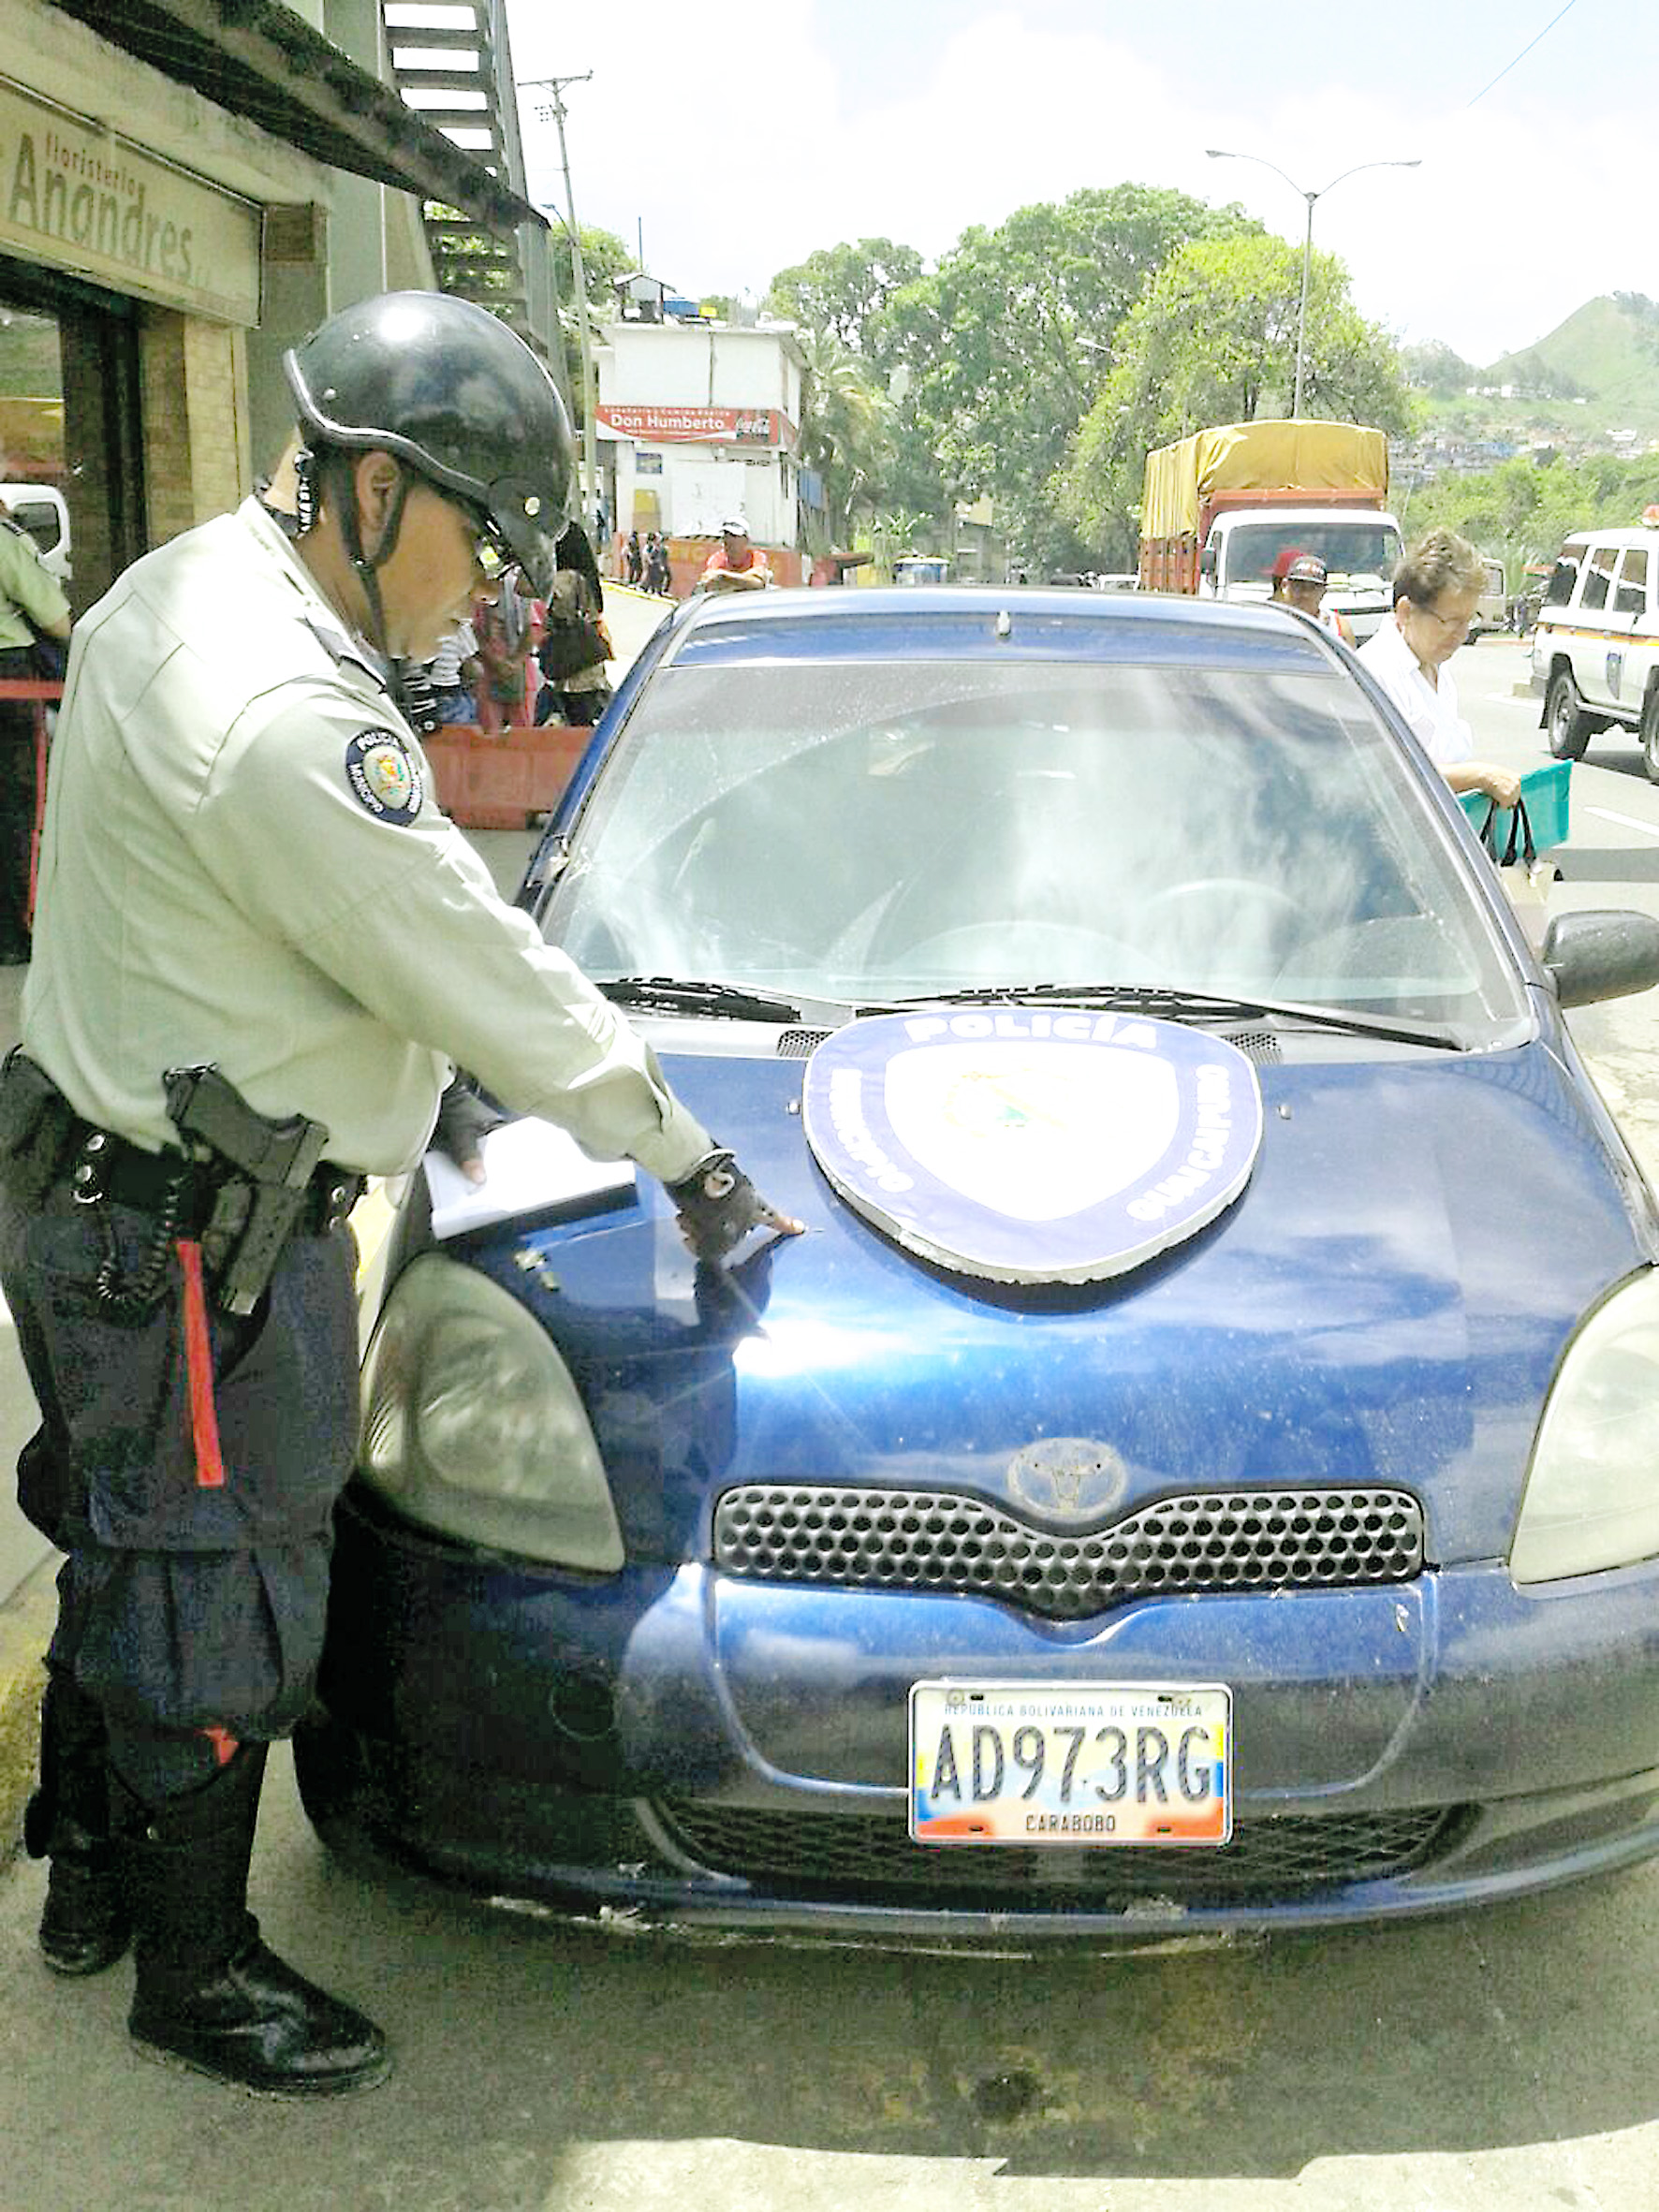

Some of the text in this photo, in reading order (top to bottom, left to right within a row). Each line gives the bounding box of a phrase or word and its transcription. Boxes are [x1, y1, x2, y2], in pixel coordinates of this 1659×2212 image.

[7, 132, 194, 279] Anandres
[610, 414, 643, 428] Don
[647, 415, 725, 430] Humberto
[1020, 1704, 1105, 1717] BOLIVARIANA
[1110, 1705, 1124, 1717] DE
[1131, 1705, 1203, 1718] VENEZUELA
[931, 1723, 1211, 1804] AD973RG
[1025, 1813, 1117, 1833] CARABOBO
